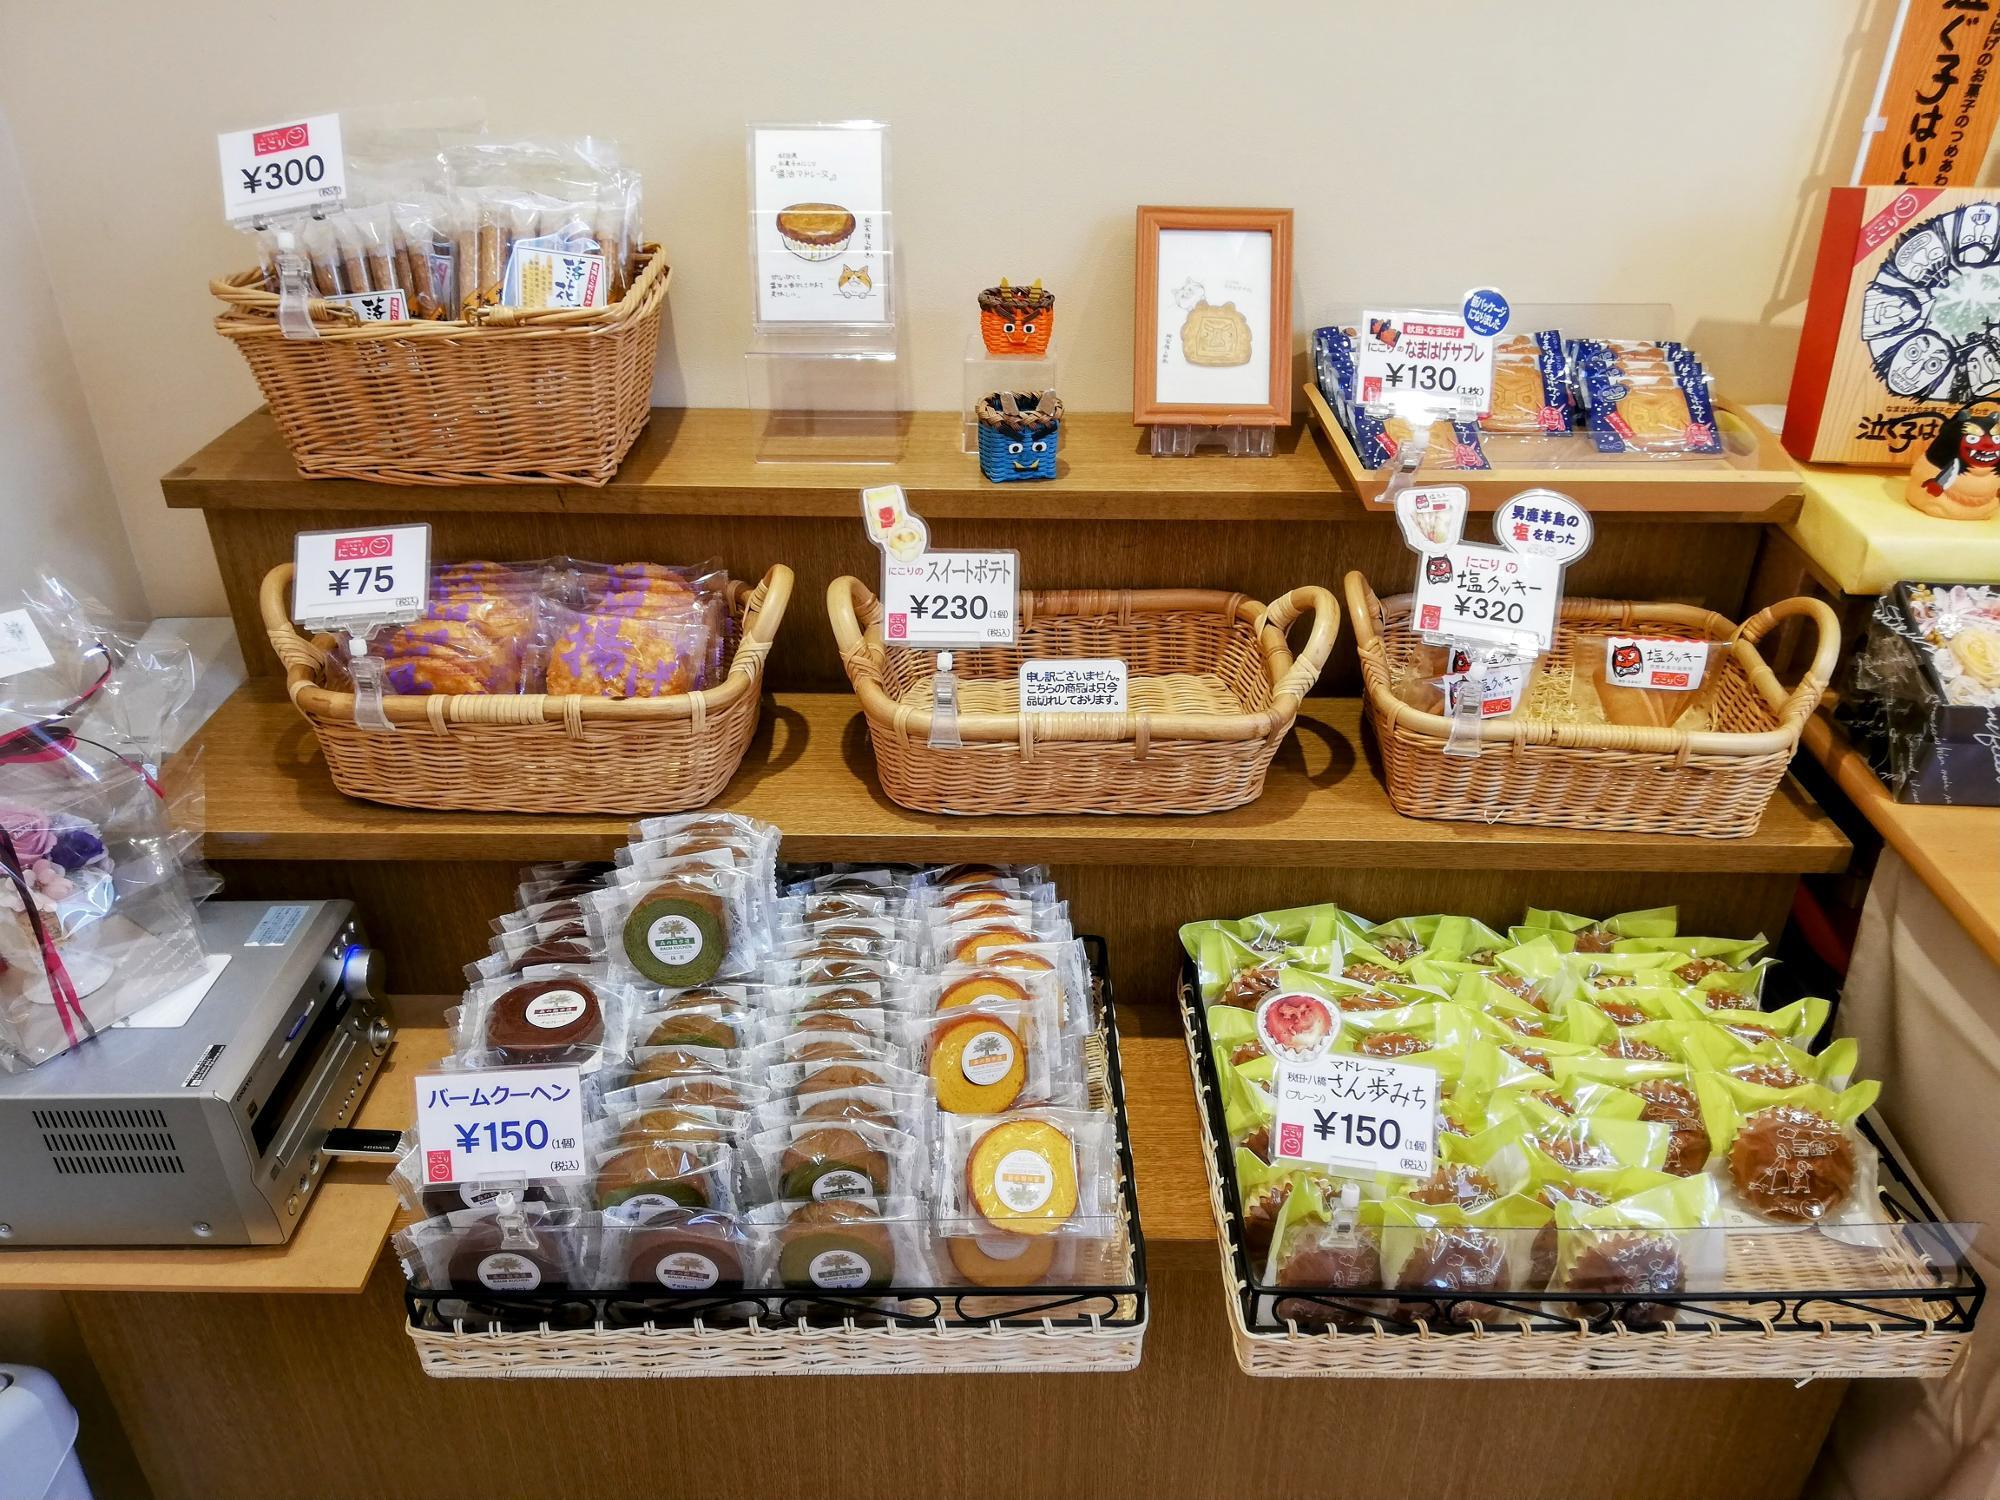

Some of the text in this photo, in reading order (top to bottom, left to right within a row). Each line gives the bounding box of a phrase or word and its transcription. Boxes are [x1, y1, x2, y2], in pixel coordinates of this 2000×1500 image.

[241, 154, 325, 194] ¥300
[1866, 216, 1899, 247] にこり
[1386, 363, 1457, 391] ¥130
[1511, 505, 1580, 528] 男鹿半島の
[888, 559, 1011, 584] にこりの スイートポテト
[1466, 556, 1518, 574] にこりの
[328, 565, 394, 596] ¥75
[1457, 570, 1542, 596] 塩クッキー
[910, 595, 988, 620] ¥230
[1454, 594, 1524, 624] ¥320
[1646, 648, 1703, 663] 塩クッキー
[1026, 670, 1120, 682] 申し訳ございません。
[1027, 682, 1118, 694] こちらの商品は只今
[1026, 694, 1119, 706] 品切れしております。
[1330, 1060, 1396, 1076] マドレーヌ
[428, 1083, 571, 1109] バームクーヘン
[1285, 1089, 1326, 1104] (プレーン)
[1328, 1074, 1427, 1109] さん歩みち
[454, 1119, 549, 1153] ¥150
[1313, 1108, 1401, 1150] ¥150
[550, 1160, 580, 1172] (税込)
[1400, 1158, 1428, 1172] (税込)
